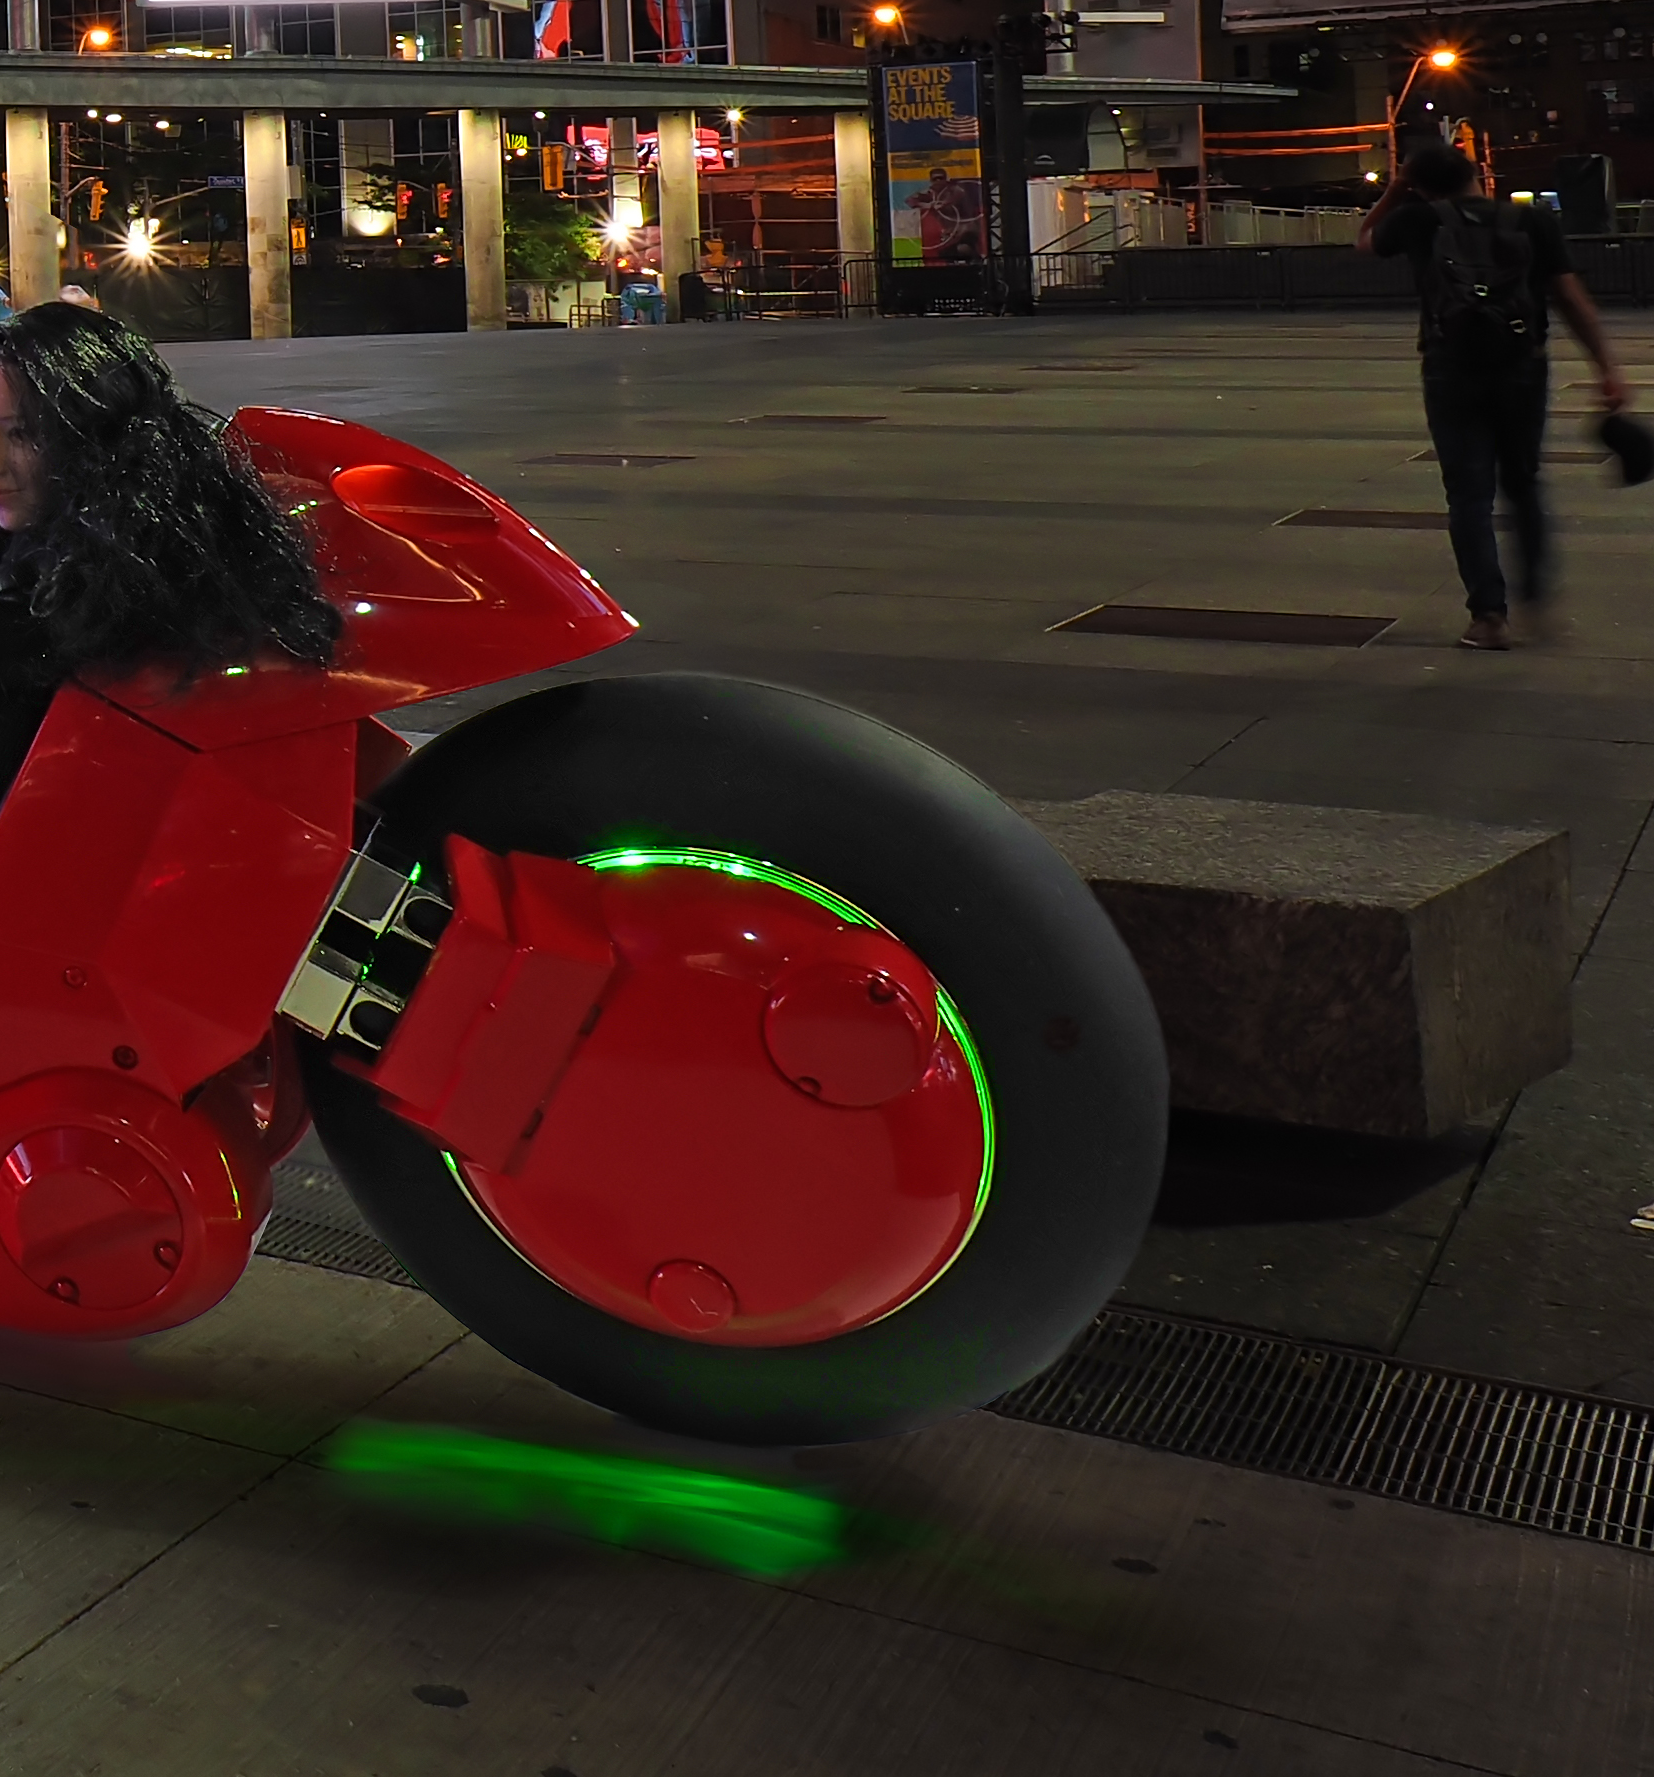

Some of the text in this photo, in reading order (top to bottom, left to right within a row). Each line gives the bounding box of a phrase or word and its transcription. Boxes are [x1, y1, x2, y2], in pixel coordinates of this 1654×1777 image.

[887, 65, 952, 87] EVENTS
[888, 84, 947, 104] AT THE
[888, 101, 956, 124] SQUARE
